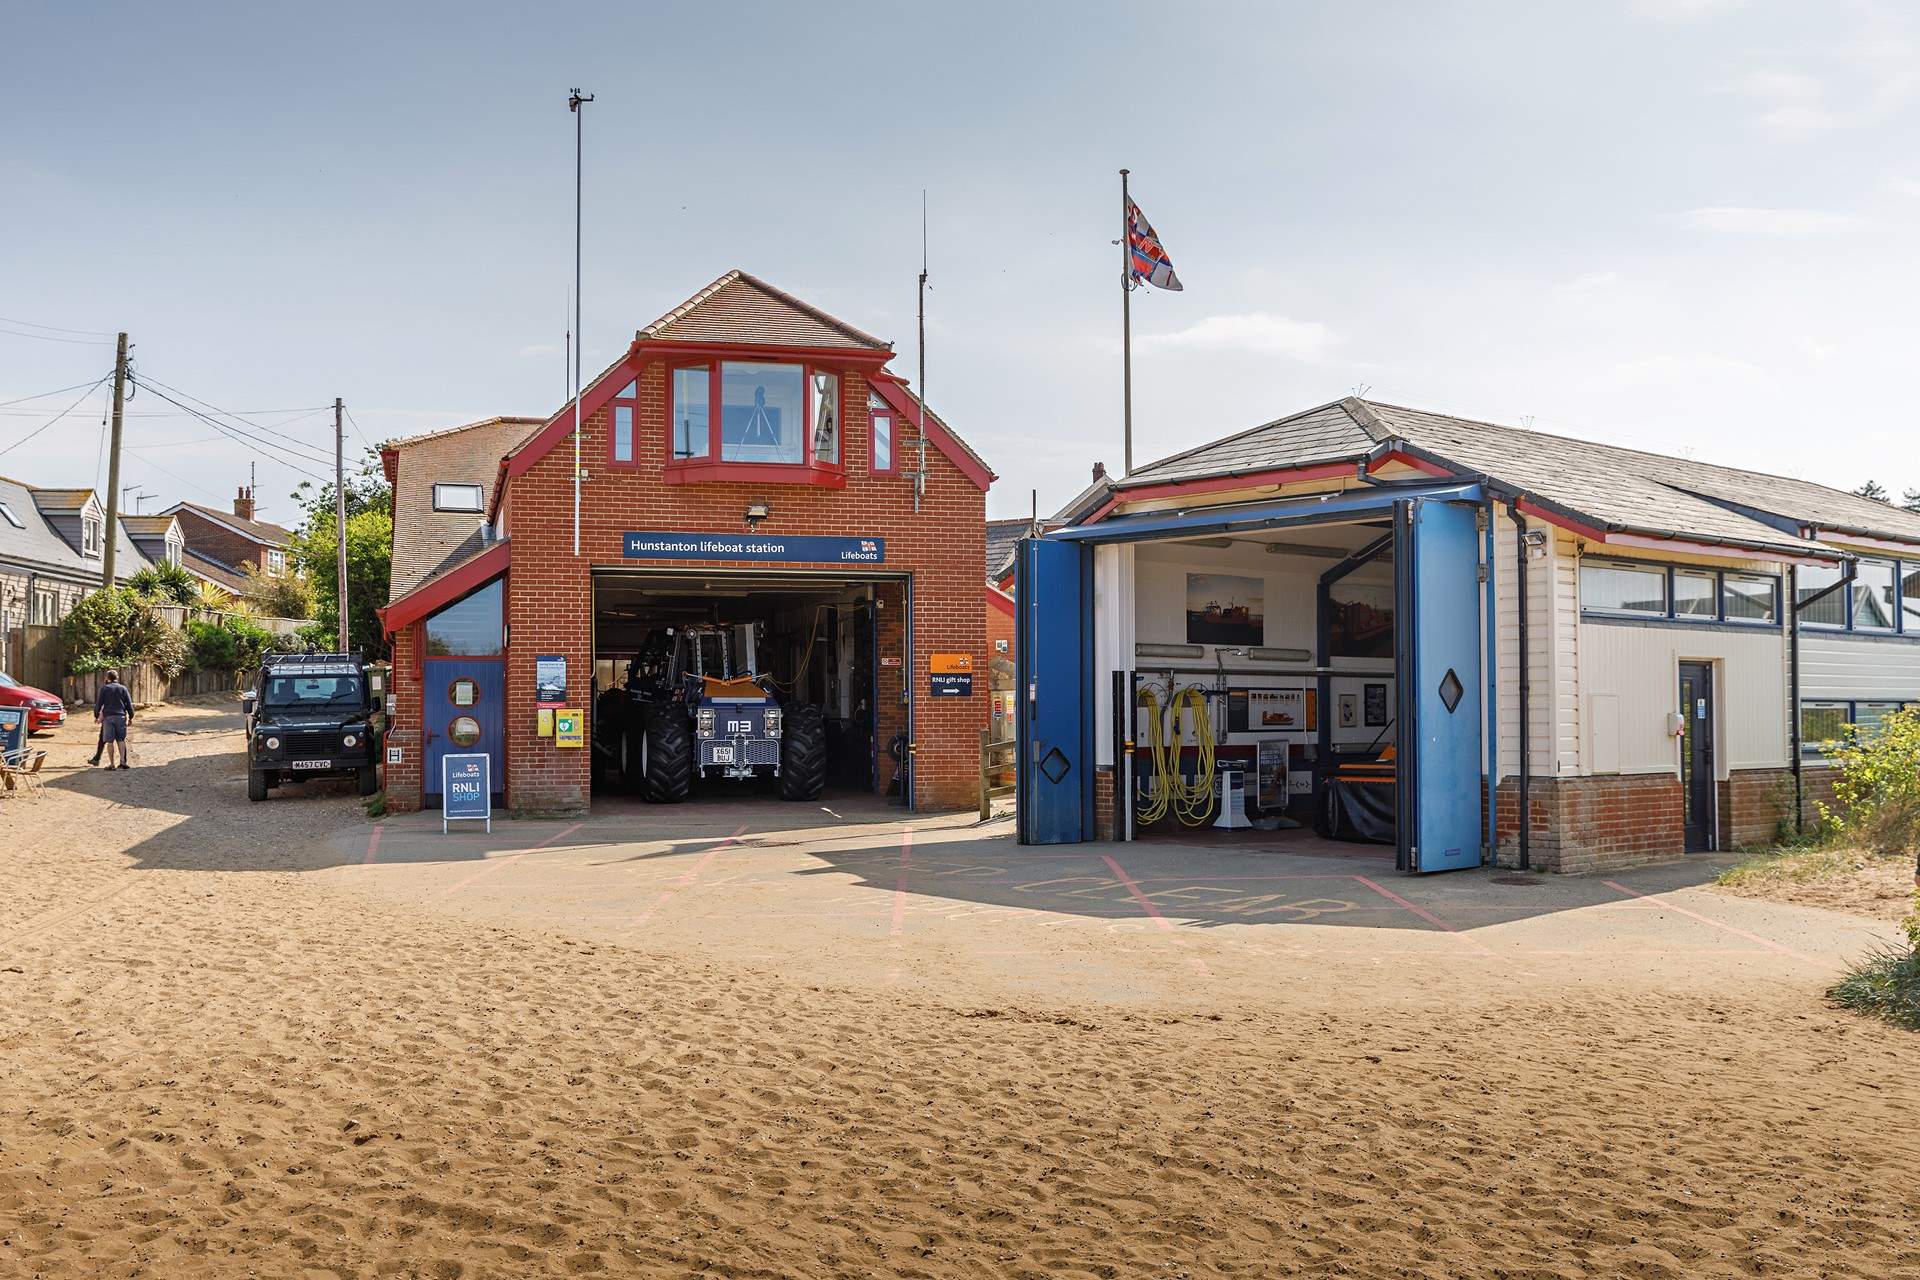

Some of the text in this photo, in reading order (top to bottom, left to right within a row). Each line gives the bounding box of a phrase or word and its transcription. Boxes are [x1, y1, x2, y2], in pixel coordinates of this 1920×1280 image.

[631, 540, 785, 553] Hunstanton lifeboat station
[841, 551, 878, 560] Lifeboats
[945, 676, 956, 684] gift
[957, 676, 971, 684] shop
[727, 720, 752, 732] M3
[452, 782, 480, 793] RNLI
[452, 792, 480, 802] SHOP
[1013, 877, 1360, 921] CLEAR
